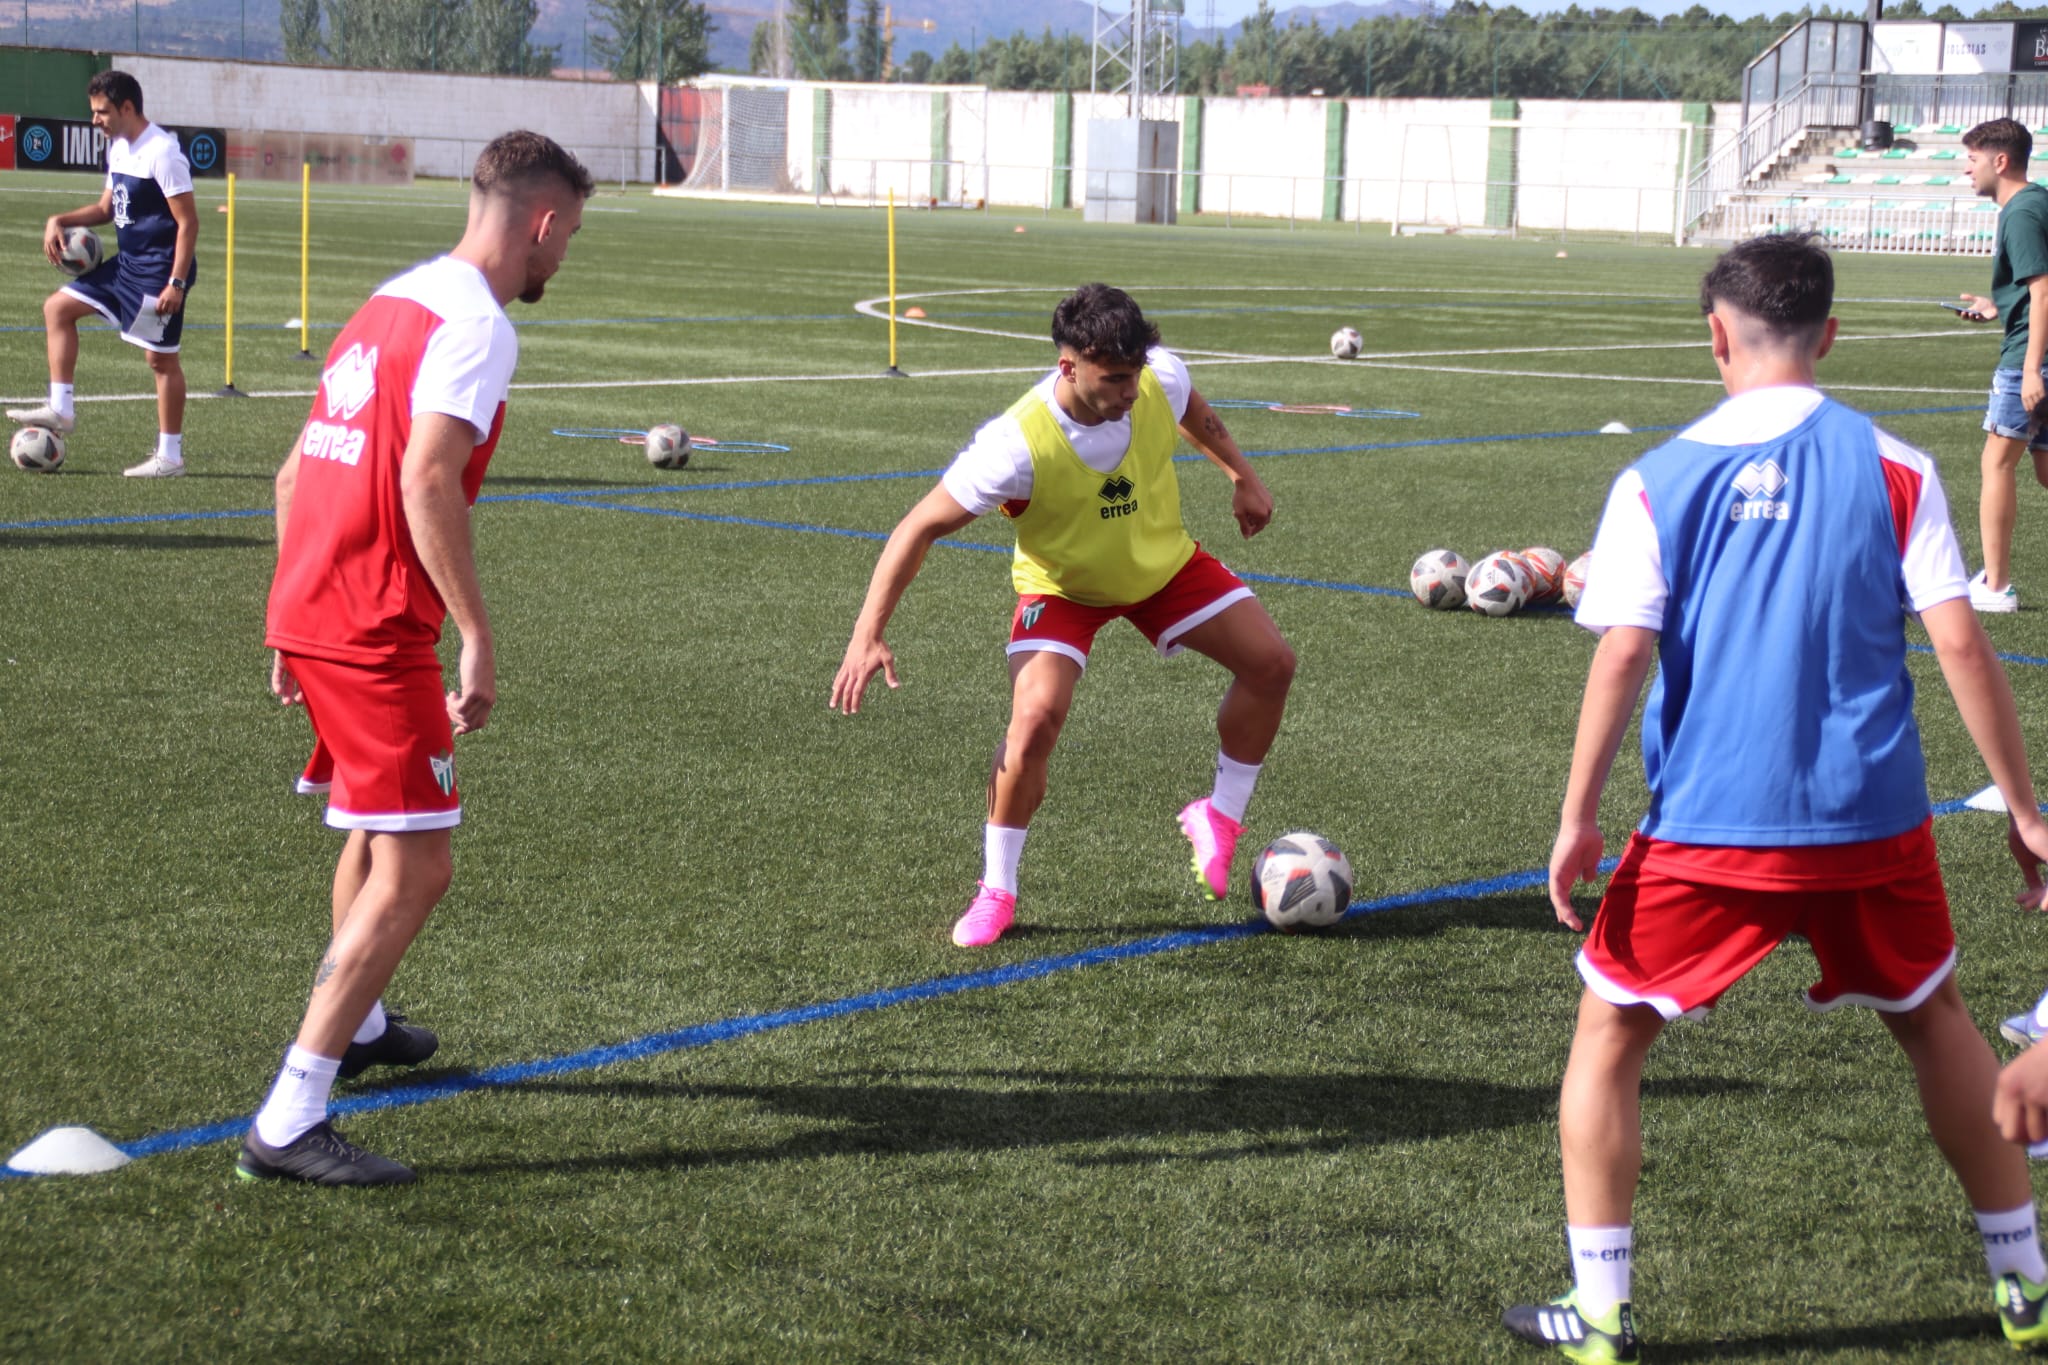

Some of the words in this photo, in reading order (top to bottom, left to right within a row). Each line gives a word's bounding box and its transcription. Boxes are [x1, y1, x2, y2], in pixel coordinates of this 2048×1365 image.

[1946, 43, 1987, 56] IGLESIAS
[302, 421, 366, 466] errea
[1100, 500, 1138, 519] errea
[1730, 500, 1789, 522] errea
[1621, 1311, 1634, 1345] COPA
